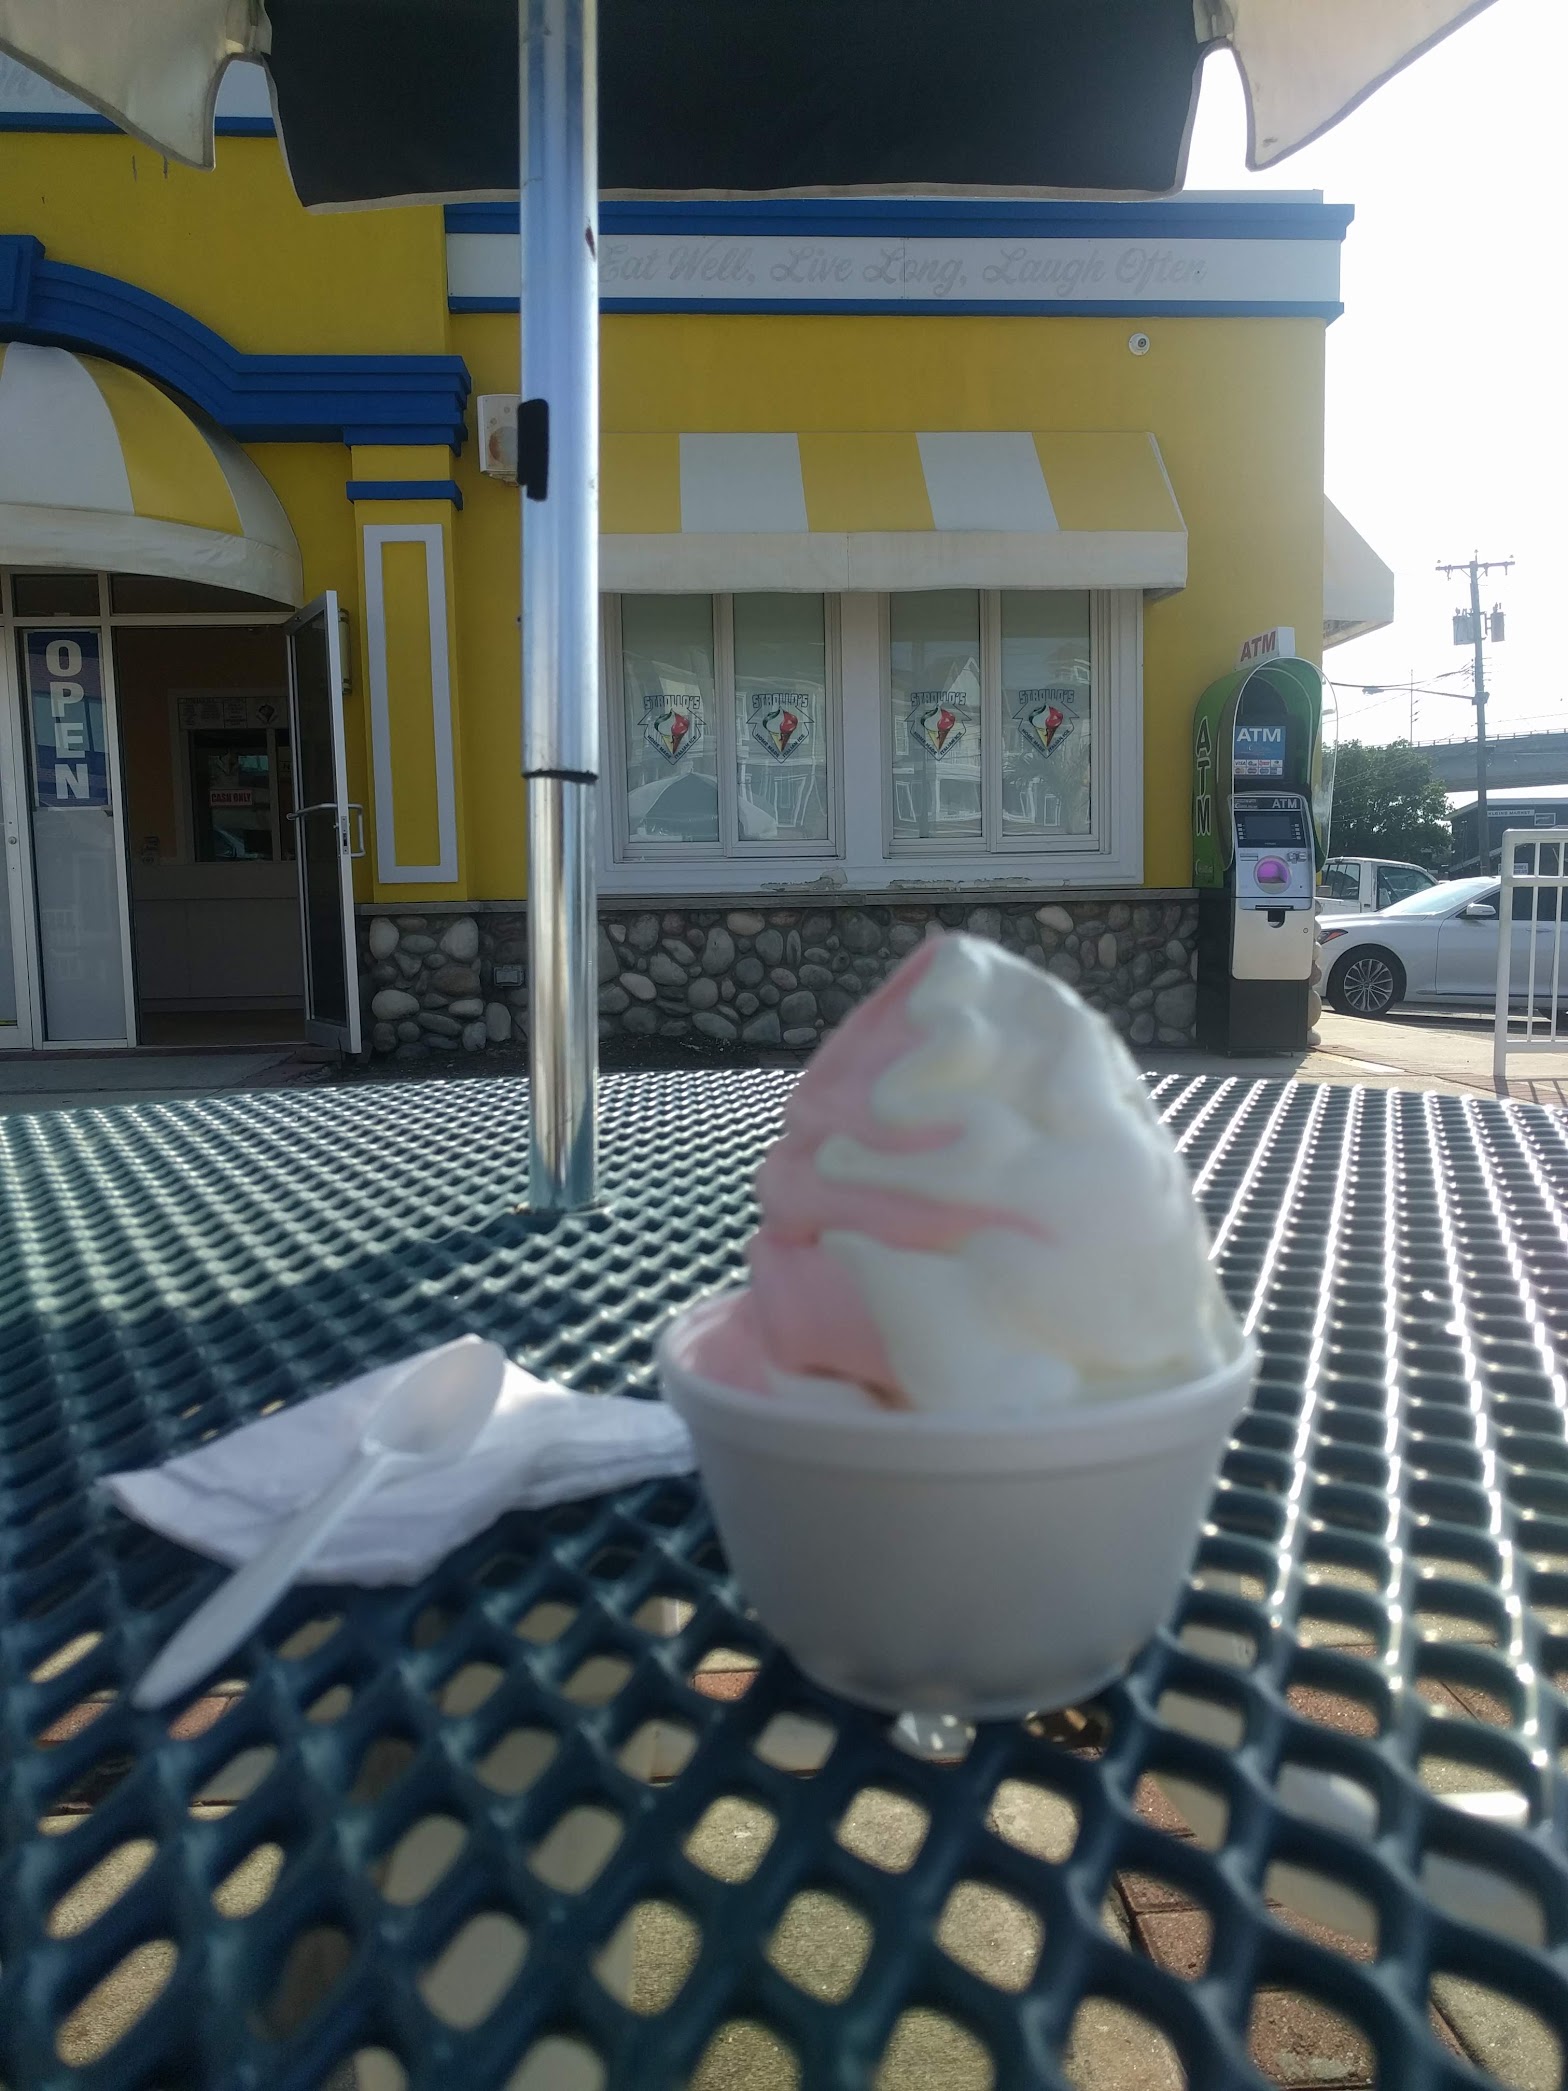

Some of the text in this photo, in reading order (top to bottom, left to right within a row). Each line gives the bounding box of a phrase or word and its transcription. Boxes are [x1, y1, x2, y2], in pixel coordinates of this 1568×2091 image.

[599, 238, 1208, 297] Eat Well, Live Long, Laugh Often
[1240, 630, 1277, 662] ATM
[644, 694, 700, 709] STROLLO'S
[752, 693, 809, 708] STROLLO'S
[911, 691, 966, 706] STROLLO'S
[1019, 689, 1075, 704] STROLLO'S
[45, 639, 90, 800] OPEN
[1236, 728, 1281, 743] ATM
[756, 733, 780, 758] HOME MADE
[783, 742, 798, 758] ITALIAN
[1195, 715, 1212, 836] ATM
[211, 792, 251, 803] CASH ONLY
[1273, 798, 1298, 809] ATM
